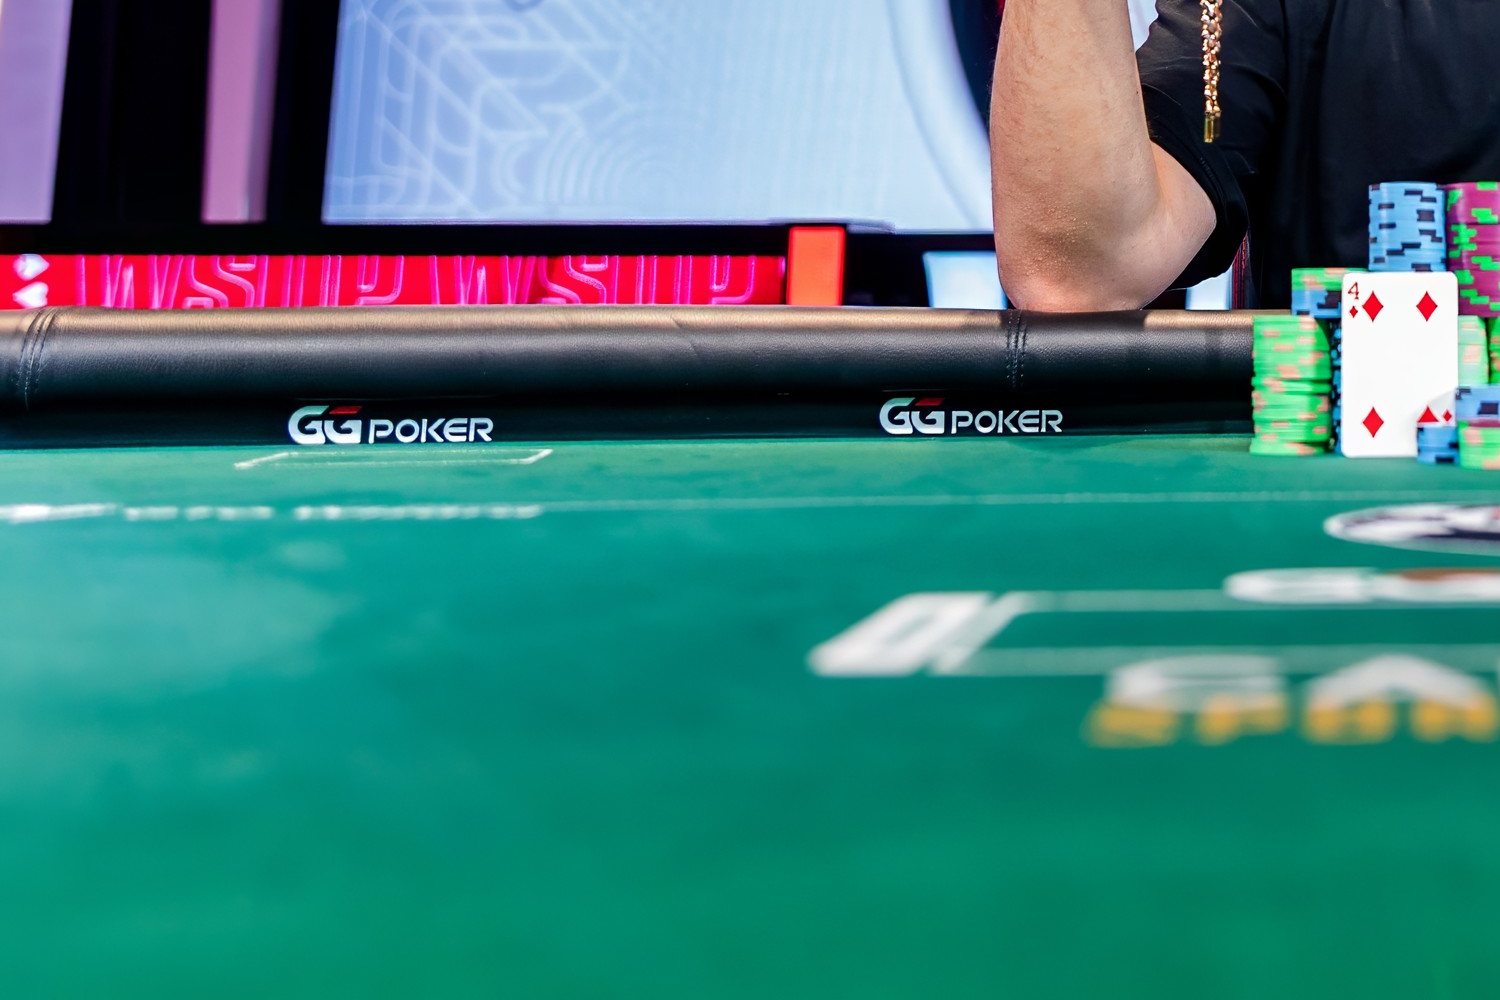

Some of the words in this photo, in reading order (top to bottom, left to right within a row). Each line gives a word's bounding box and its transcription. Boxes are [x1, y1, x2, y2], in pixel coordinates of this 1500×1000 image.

[1347, 281, 1360, 300] 4
[368, 417, 494, 444] POKER
[951, 409, 1064, 434] POKER
